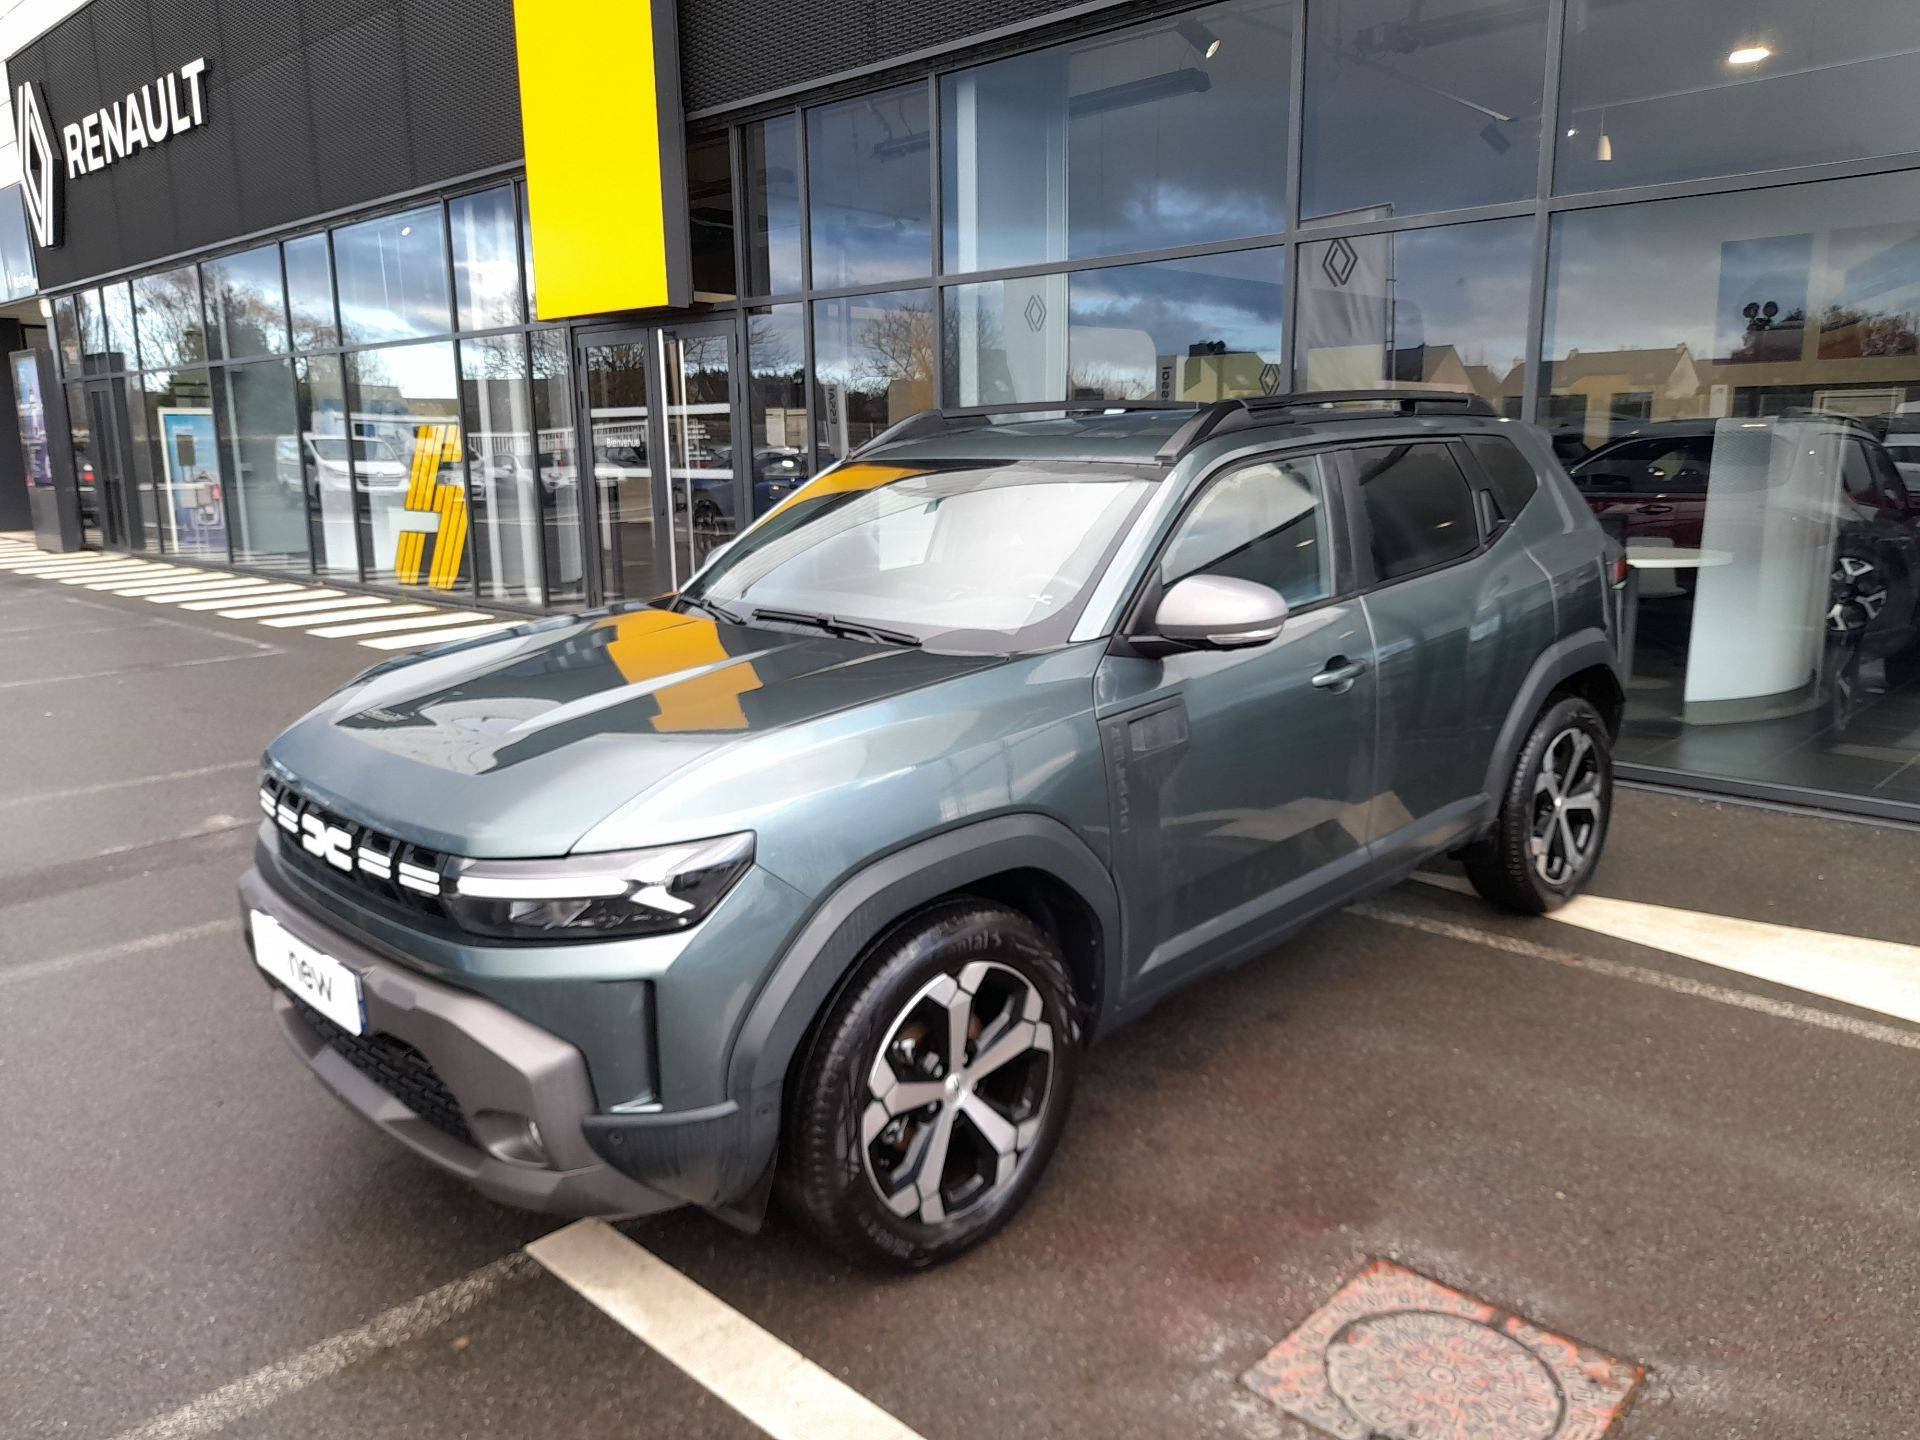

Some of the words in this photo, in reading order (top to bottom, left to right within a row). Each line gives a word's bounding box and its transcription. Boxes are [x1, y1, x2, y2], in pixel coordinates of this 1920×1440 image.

[63, 57, 206, 179] RENAULT
[606, 437, 641, 448] Bienvenue
[288, 951, 332, 1002] new
